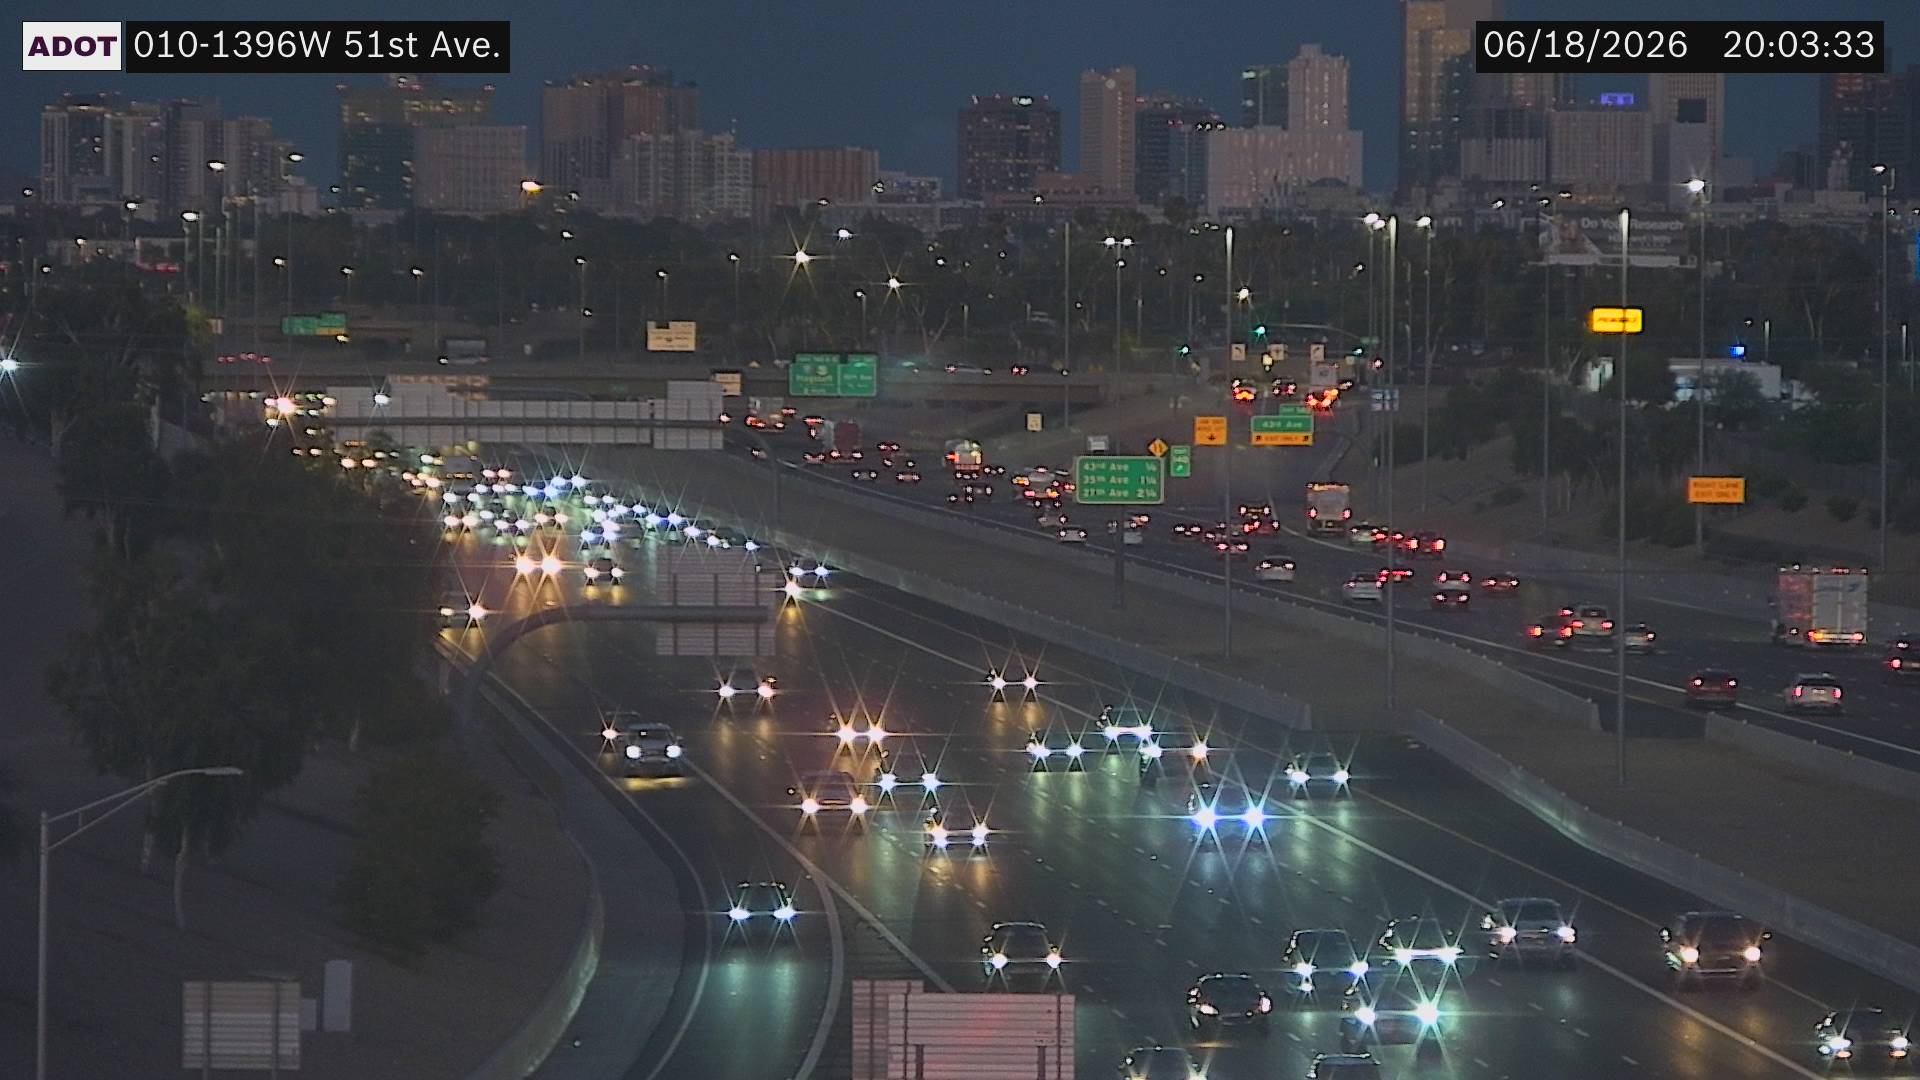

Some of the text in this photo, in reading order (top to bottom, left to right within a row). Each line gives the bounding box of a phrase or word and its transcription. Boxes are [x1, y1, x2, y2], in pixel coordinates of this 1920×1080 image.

[1083, 463, 1106, 472] 43rd
[1109, 463, 1129, 472] Ave
[1083, 475, 1106, 484] 35th
[1109, 475, 1129, 484] Ave
[1083, 488, 1106, 497] 27th
[1109, 488, 1129, 497] Ave
